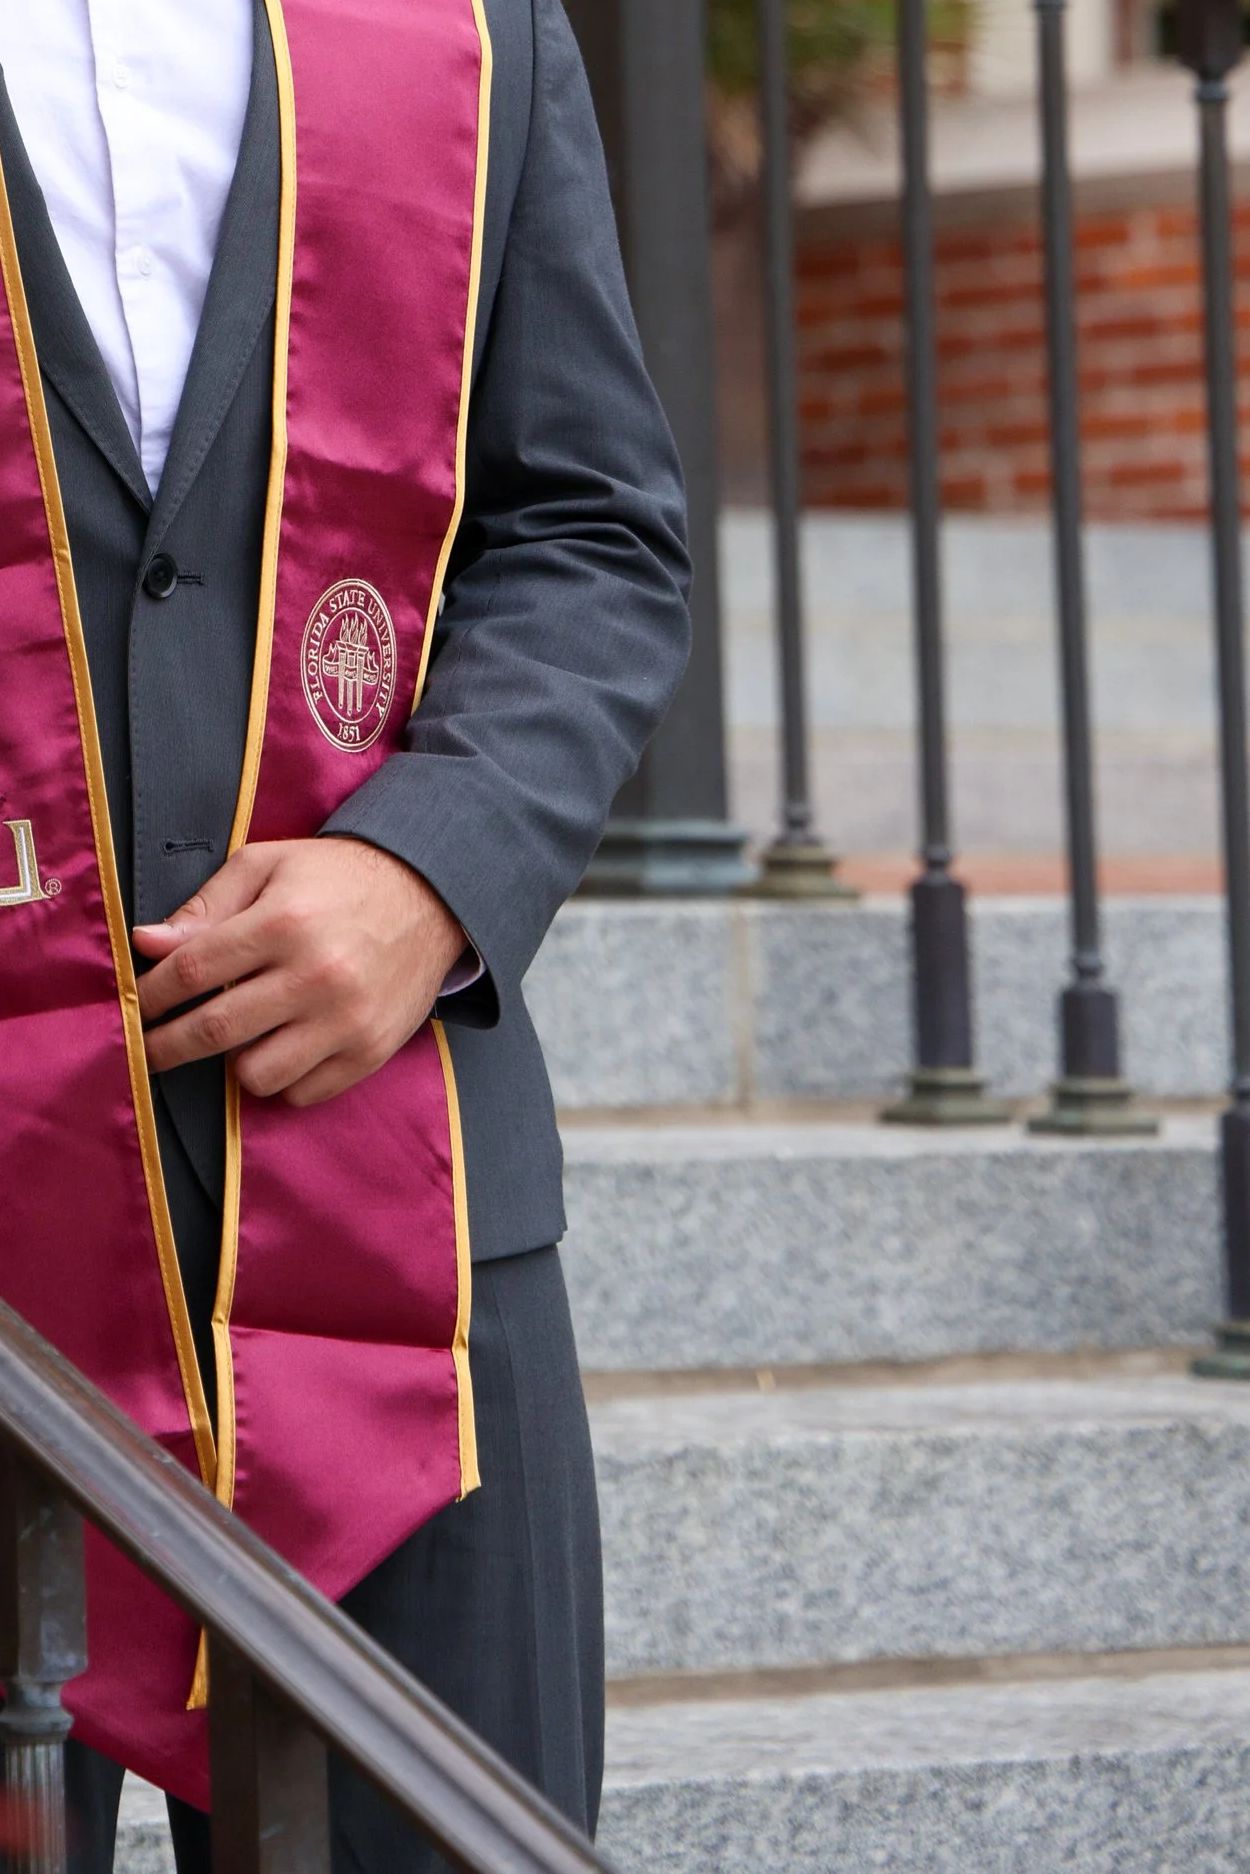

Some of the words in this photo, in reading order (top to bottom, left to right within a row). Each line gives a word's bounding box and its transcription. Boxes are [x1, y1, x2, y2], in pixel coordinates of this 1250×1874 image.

[307, 612, 329, 705] FLORIDA
[329, 589, 366, 610] STATE
[367, 599, 391, 718] UNIVERSITY
[337, 722, 361, 741] 1851
